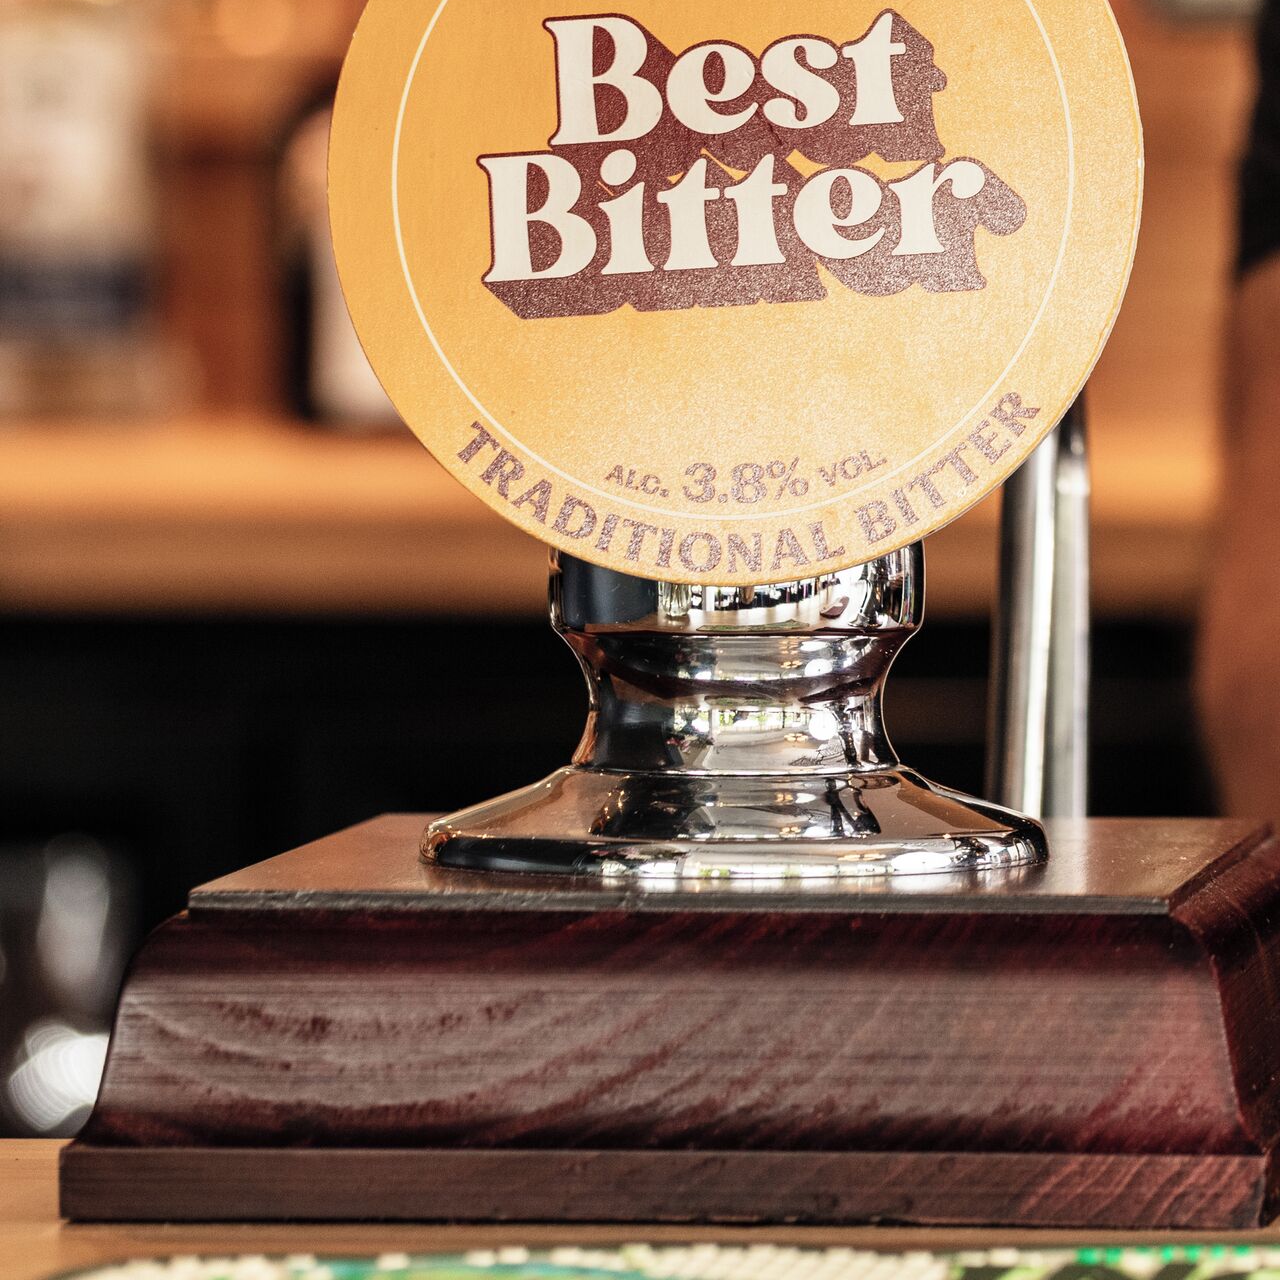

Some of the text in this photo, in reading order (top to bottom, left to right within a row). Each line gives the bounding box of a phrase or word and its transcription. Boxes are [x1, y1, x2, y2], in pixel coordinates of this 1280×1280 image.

[544, 9, 910, 147] Best
[480, 148, 988, 284] Bitter
[455, 391, 1042, 574] TRADITIONAL BITTER
[603, 449, 888, 504] ALC. 3.8% VOL.
